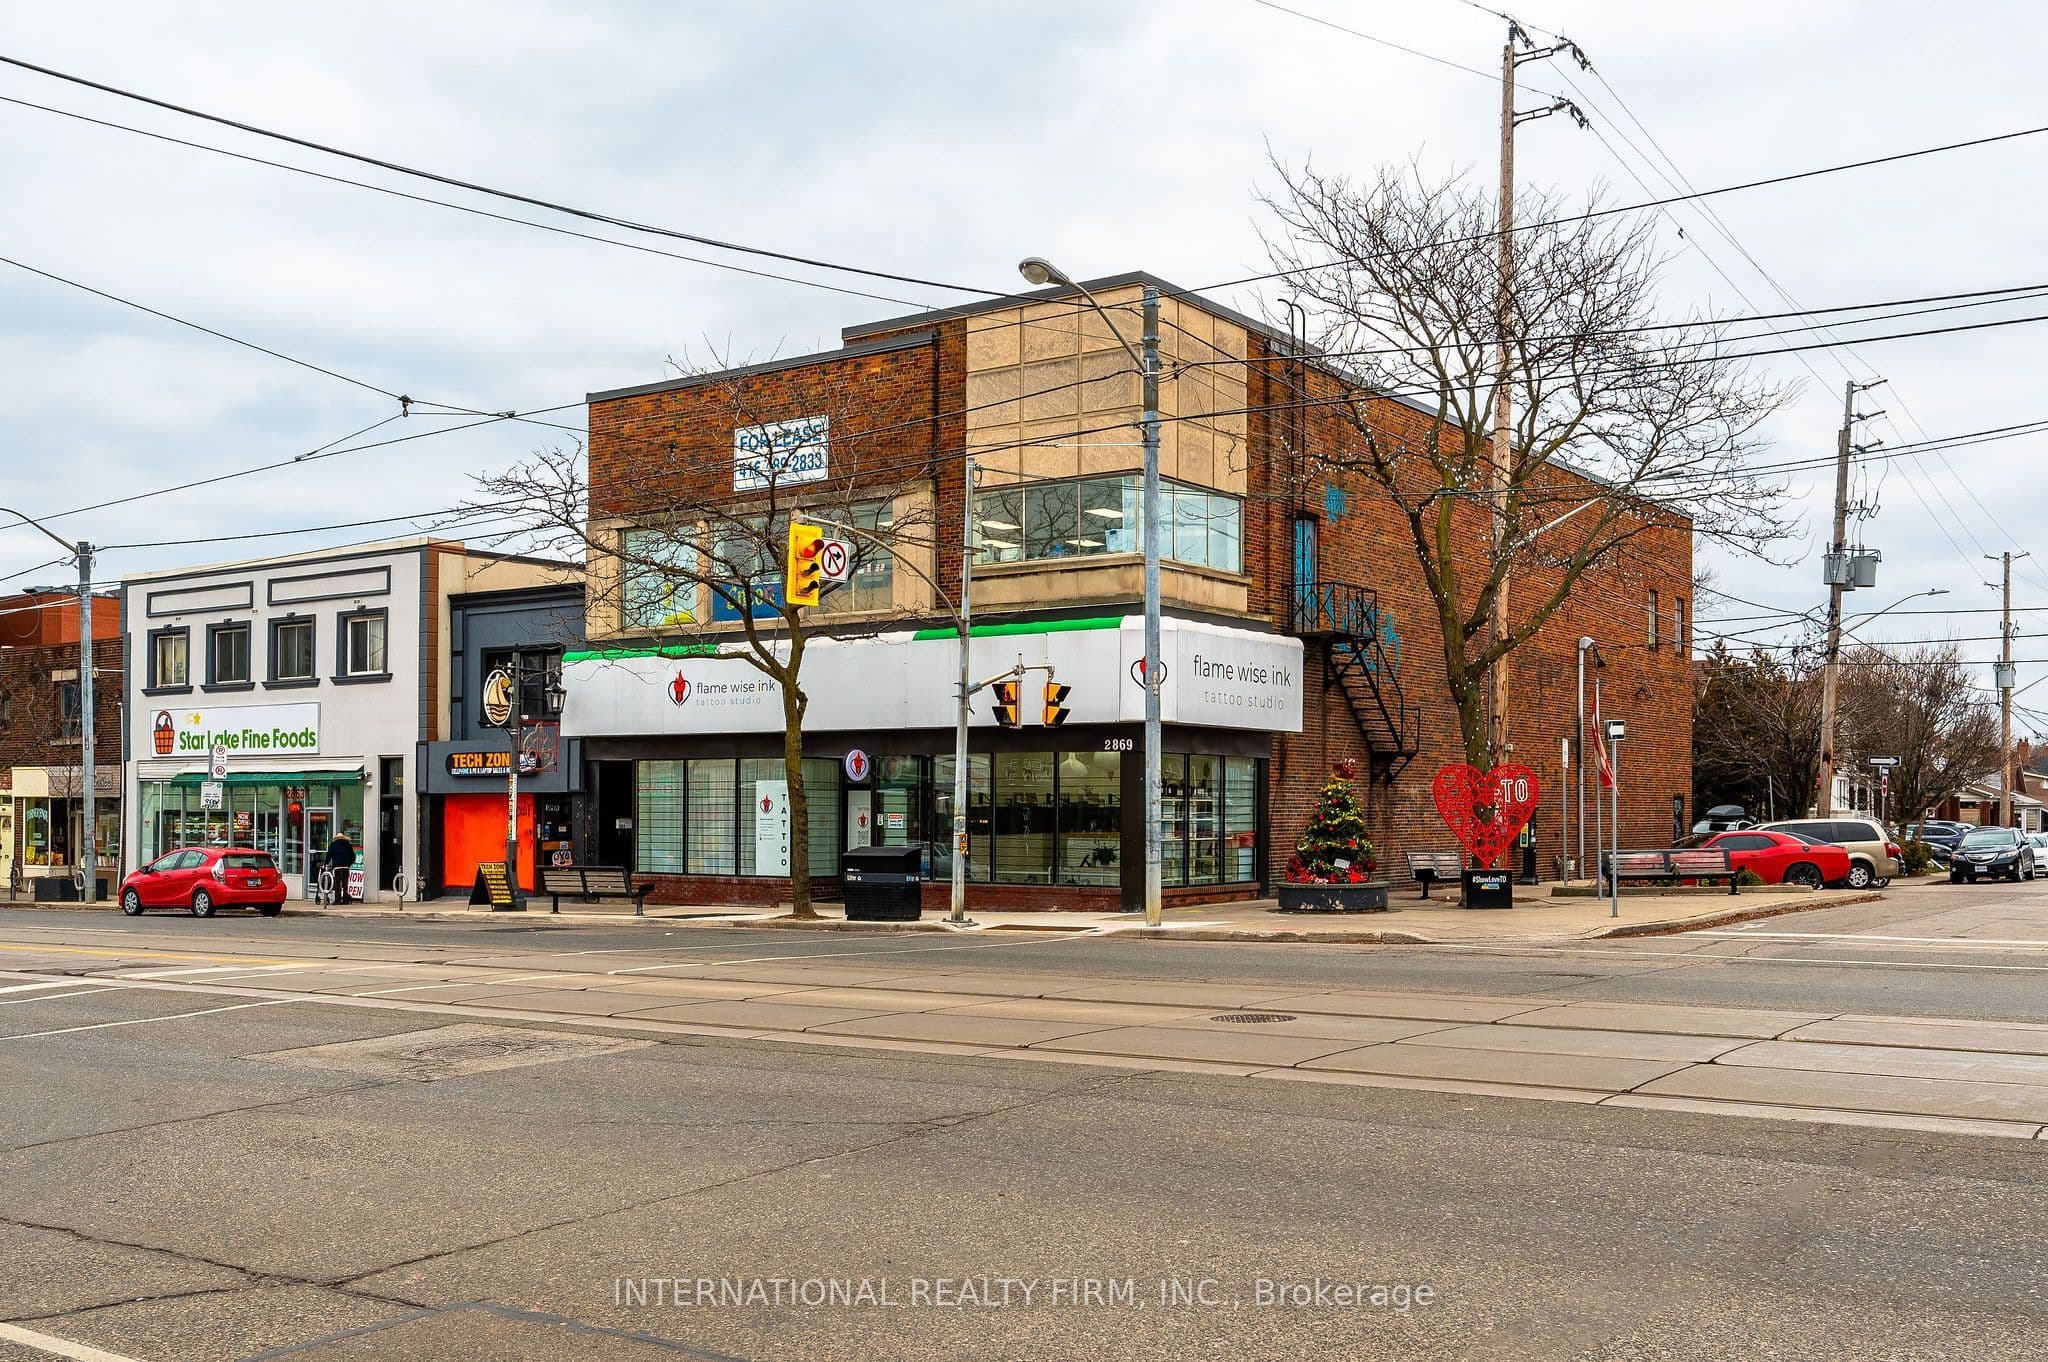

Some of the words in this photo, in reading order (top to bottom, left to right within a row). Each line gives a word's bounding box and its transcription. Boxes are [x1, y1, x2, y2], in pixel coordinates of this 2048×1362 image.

[772, 424, 822, 447] LEASE
[1194, 654, 1234, 680] flame
[1238, 662, 1267, 684] wise
[1272, 665, 1291, 687] ink
[697, 682, 727, 694] flame
[731, 680, 755, 693] wise
[758, 679, 776, 692] ink
[696, 698, 726, 706] tattoo
[731, 696, 761, 705] studio
[1205, 691, 1243, 706] tattoo
[1248, 696, 1284, 710] studio
[180, 730, 205, 750] Star
[208, 730, 239, 749] Lake
[242, 729, 270, 749] Fine
[273, 727, 316, 748] Foods
[1104, 739, 1133, 750] 2869
[453, 753, 482, 767] TECH
[486, 752, 510, 767] ZON
[1501, 779, 1528, 802] TO
[1472, 875, 1507, 884] #ShowLoveTO
[349, 886, 363, 897] PEN
